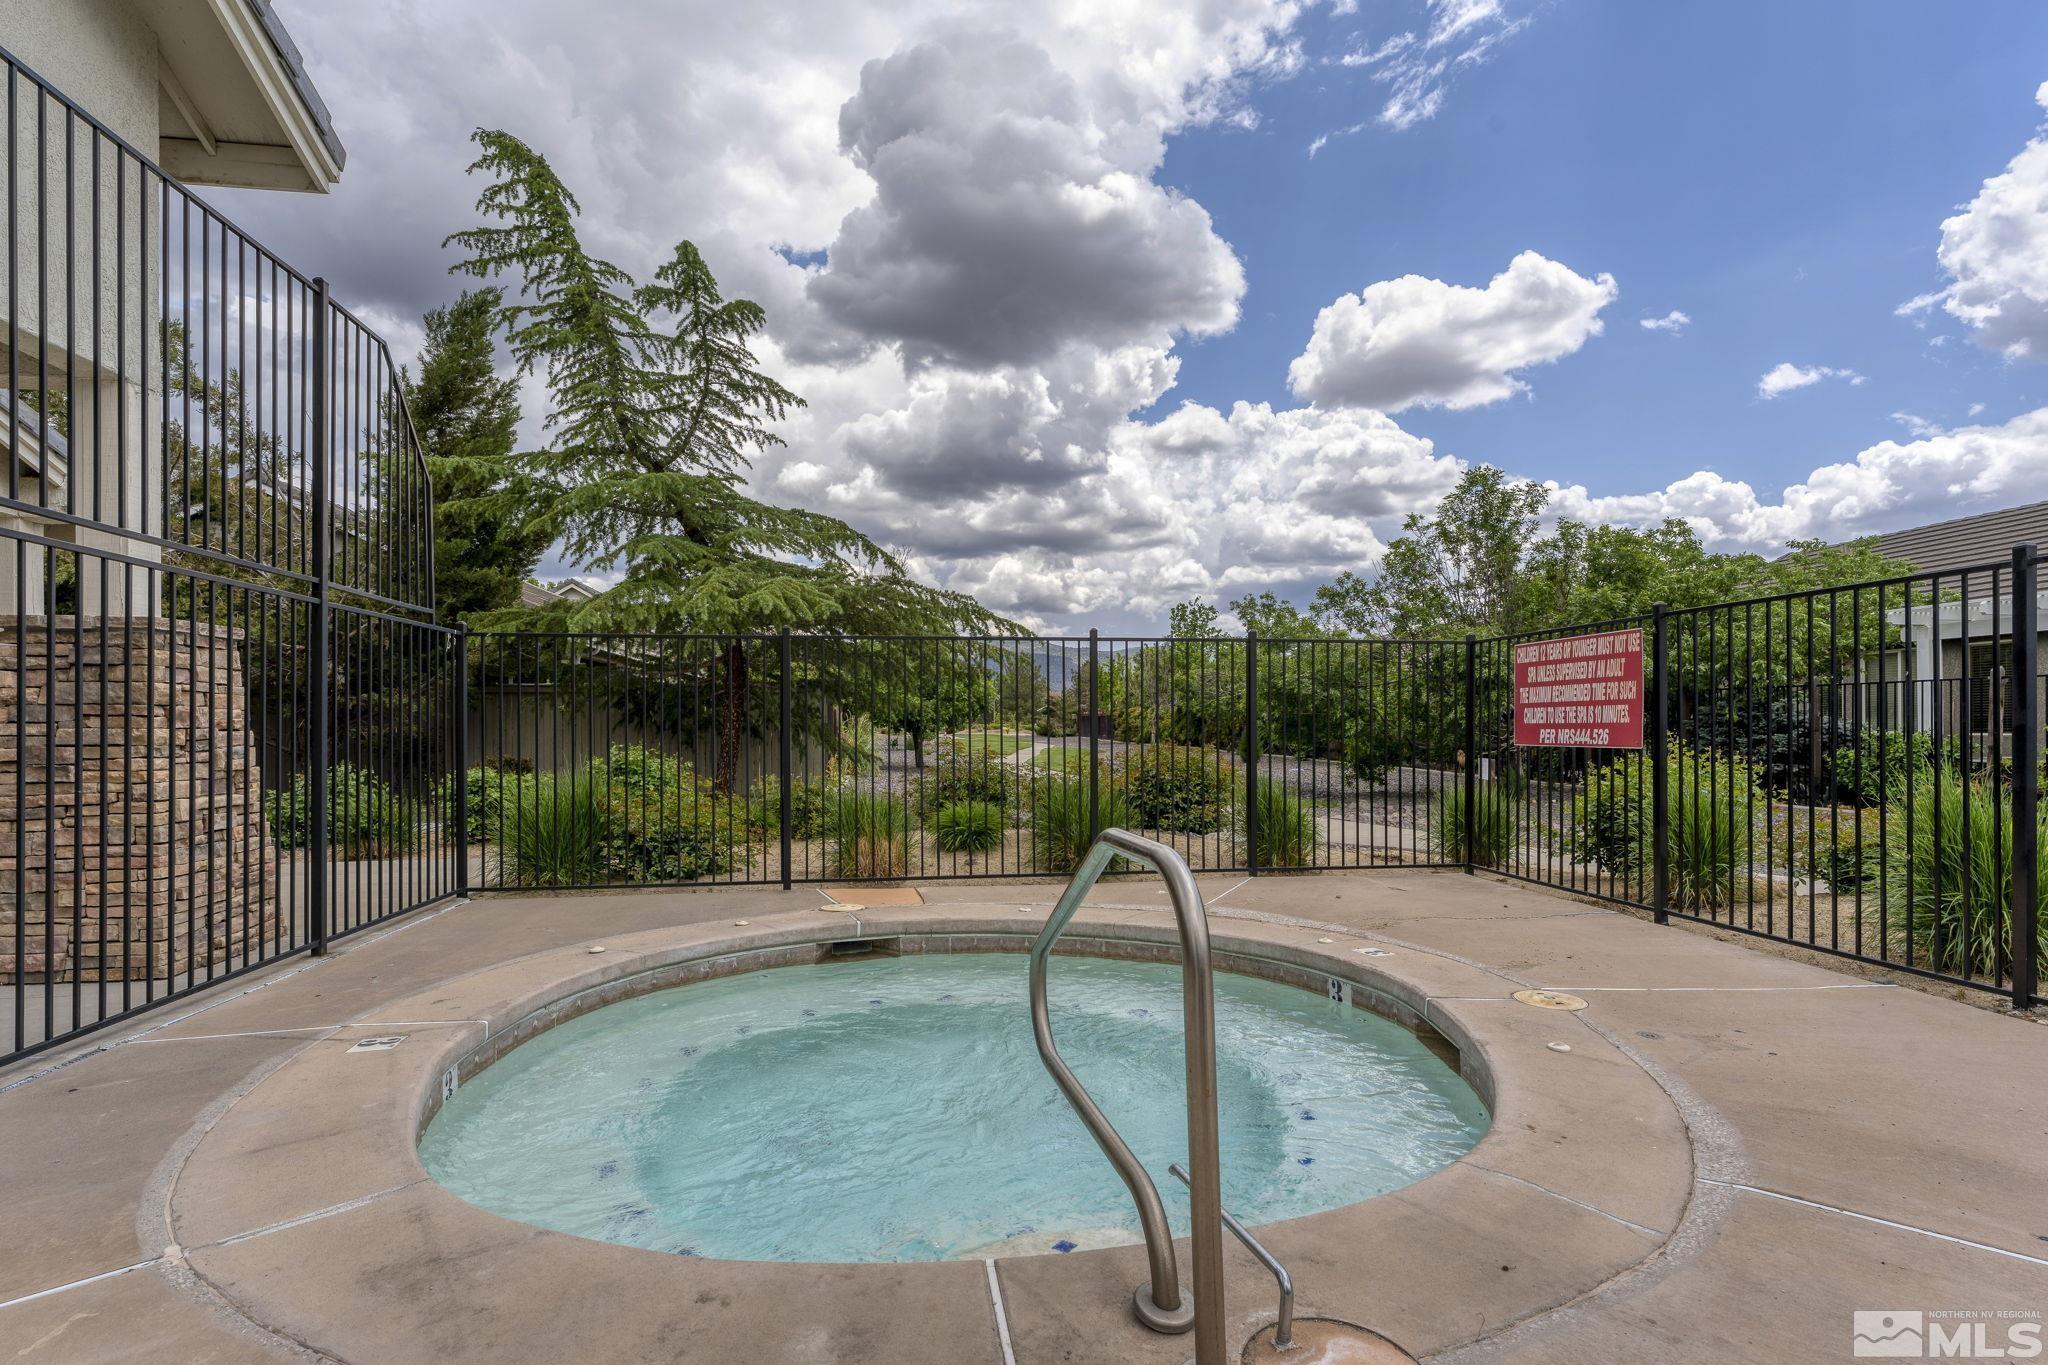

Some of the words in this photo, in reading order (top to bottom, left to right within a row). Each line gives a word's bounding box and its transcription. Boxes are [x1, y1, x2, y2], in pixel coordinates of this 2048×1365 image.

[1516, 645, 1540, 664] CHILDREN
[1540, 644, 1546, 661] 12
[1546, 642, 1563, 661] YEARS
[1563, 641, 1571, 659] OR
[1572, 638, 1597, 658] YOUNGER
[1597, 636, 1614, 655] MUST
[1614, 634, 1626, 653] NOT
[1627, 633, 1640, 652] USE
[1527, 666, 1537, 683] SPA
[1537, 664, 1556, 682] UNLESS
[1556, 661, 1588, 681] SUPERVISED
[1588, 660, 1596, 679] BY
[1597, 659, 1606, 678] AN
[1606, 657, 1626, 677] ADULT
[1519, 687, 1529, 704] THE
[1529, 686, 1552, 703] MAXIMUM
[1552, 683, 1591, 702] RECOMMENDED
[1592, 682, 1606, 701] TIME
[1606, 681, 1619, 700] FOR
[1619, 680, 1637, 700] SUCH
[1523, 707, 1547, 724] CHILDREN
[1547, 706, 1554, 724] TO
[1555, 706, 1565, 724] USE
[1566, 706, 1577, 724] THE
[1576, 705, 1587, 724] SPA
[1587, 705, 1594, 724] IS
[1595, 705, 1602, 724] 10
[1602, 704, 1630, 724] MINUTES.
[1539, 728, 1556, 744] PER
[1557, 728, 1609, 745] NRS444.526
